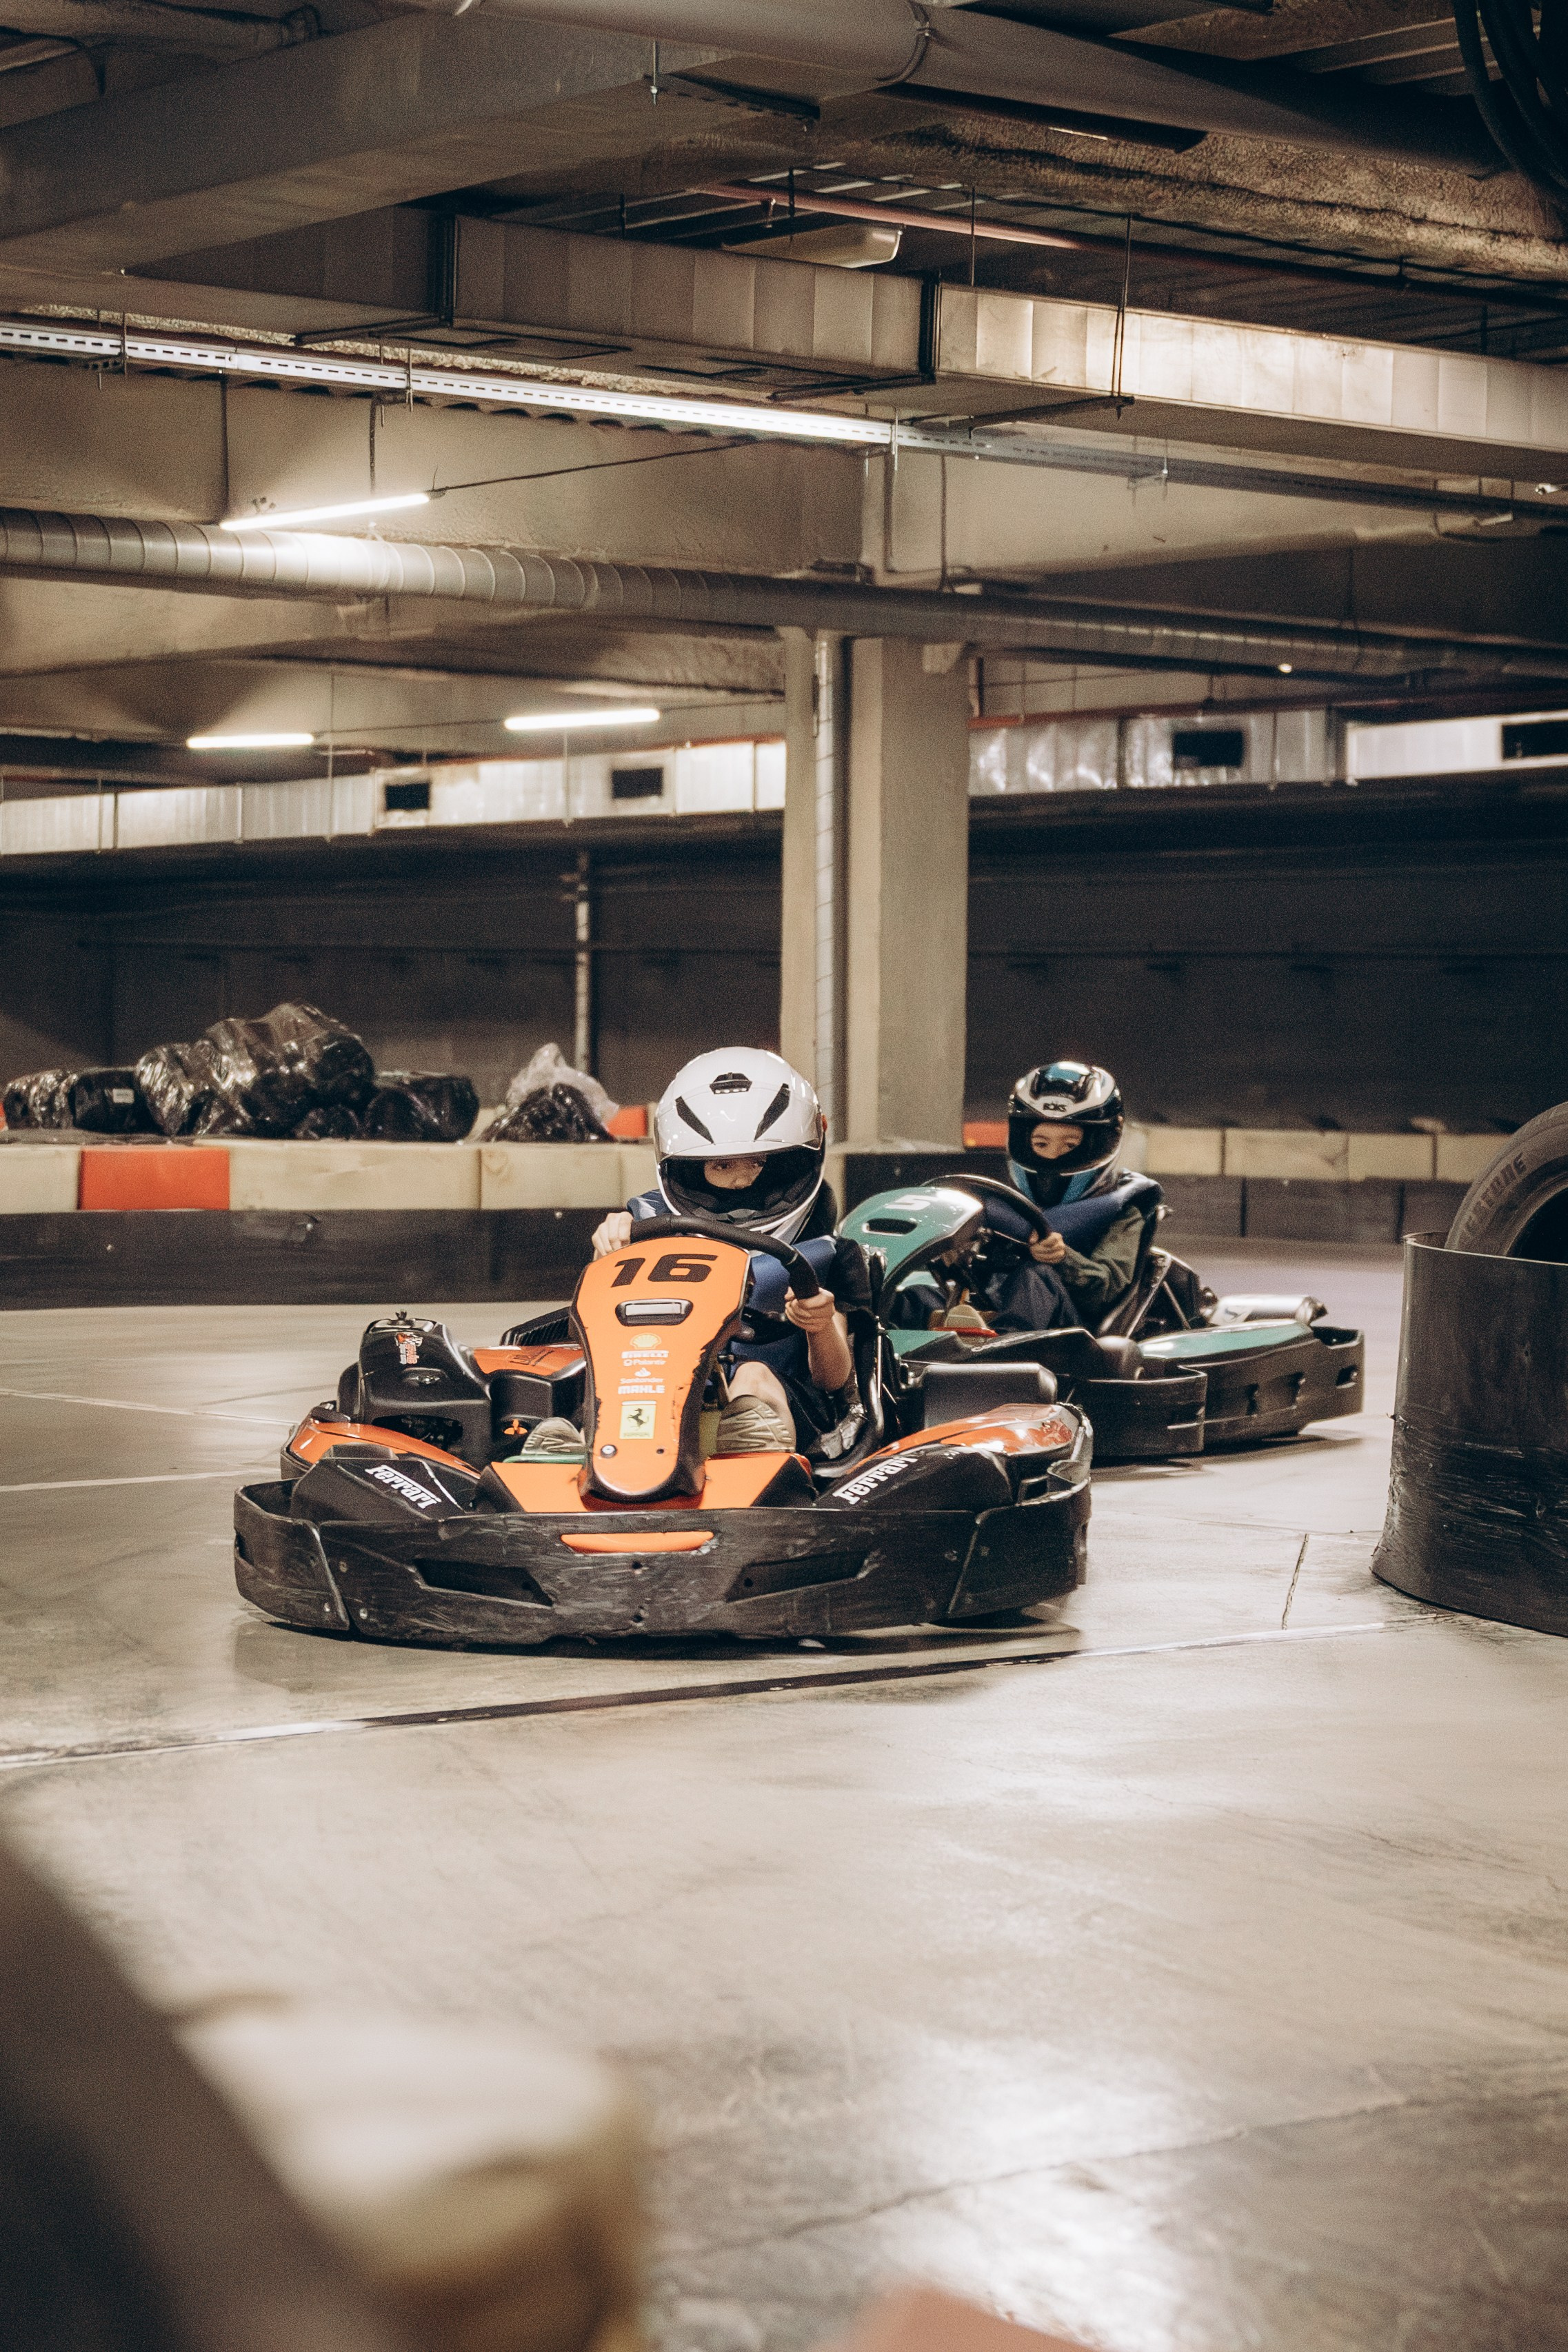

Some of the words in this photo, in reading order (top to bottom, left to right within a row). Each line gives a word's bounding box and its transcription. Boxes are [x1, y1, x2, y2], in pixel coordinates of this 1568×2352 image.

[885, 1194, 939, 1211] 5
[610, 1254, 718, 1287] 16
[618, 1385, 665, 1394] MAHLE
[365, 1465, 442, 1509] Ferrari
[832, 1455, 920, 1505] Ferrari
